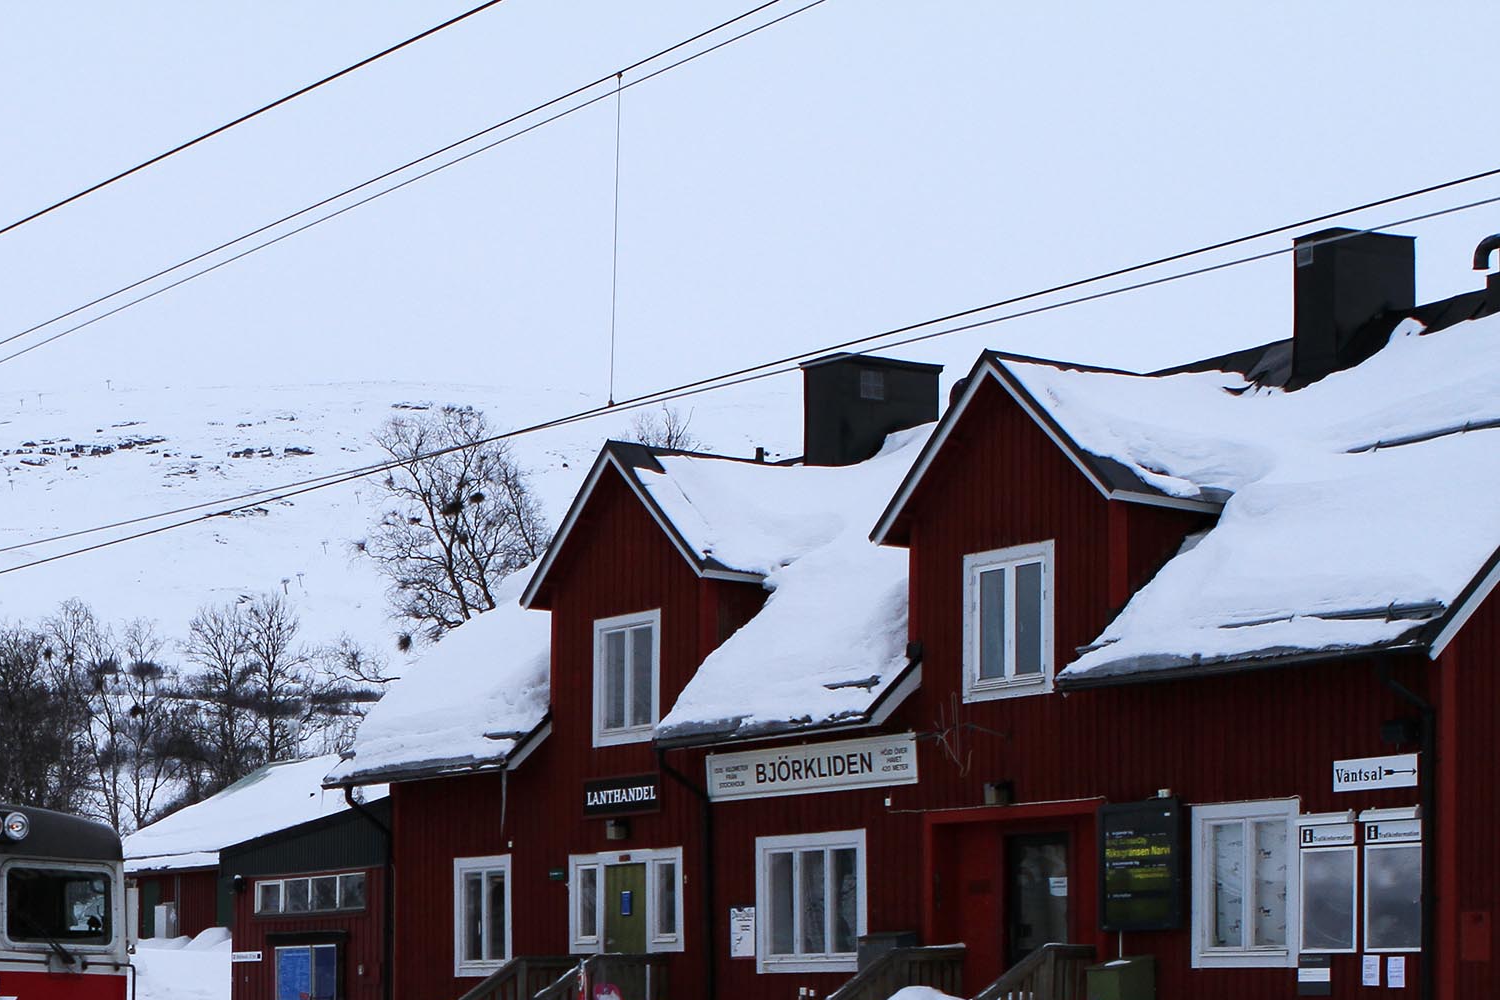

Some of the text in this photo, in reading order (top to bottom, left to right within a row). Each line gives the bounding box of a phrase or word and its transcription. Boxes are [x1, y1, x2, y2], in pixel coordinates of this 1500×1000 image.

[756, 752, 873, 784] BJÖRKLIDEN
[1335, 765, 1382, 783] Väntsal
[587, 785, 656, 806] LANTHANDEL
